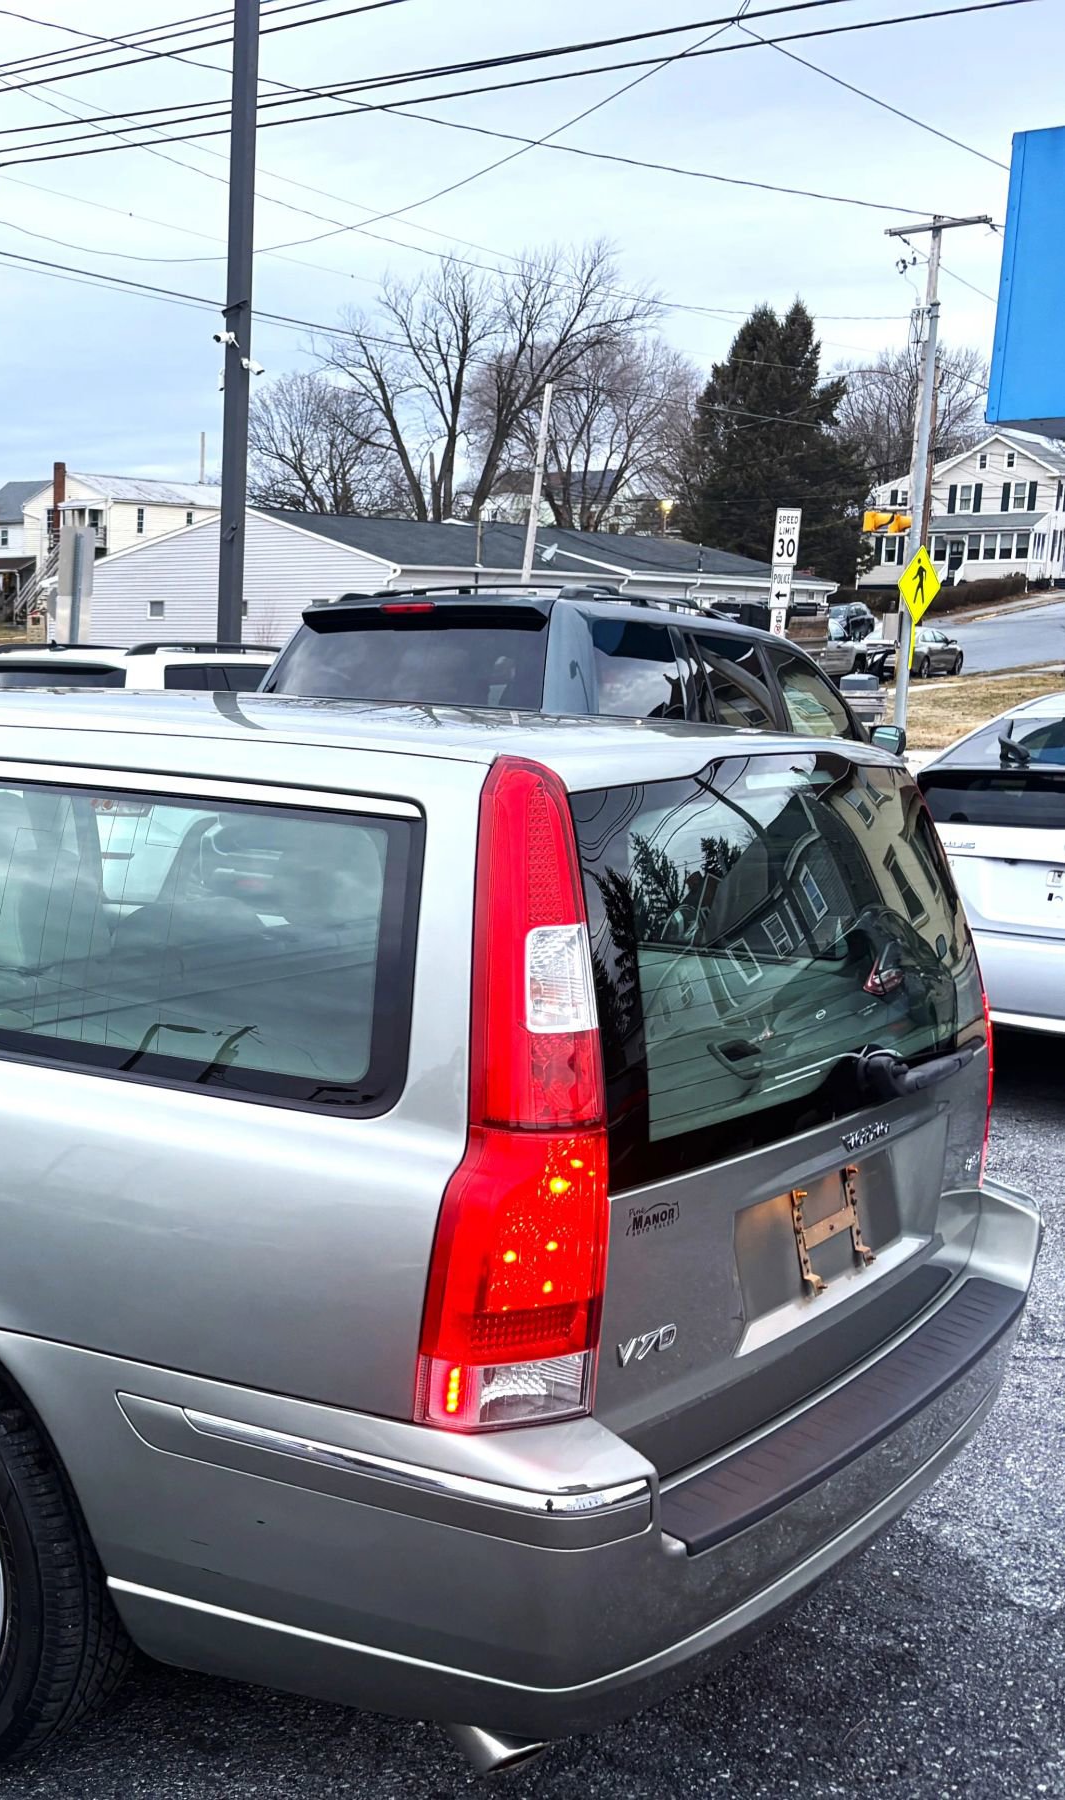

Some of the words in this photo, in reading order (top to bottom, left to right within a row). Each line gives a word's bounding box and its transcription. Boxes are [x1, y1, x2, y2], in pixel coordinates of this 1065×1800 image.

[778, 515, 799, 524] SPEED
[779, 526, 795, 535] LIMIT
[776, 538, 796, 557] 30
[773, 573, 791, 585] POLICE
[632, 1207, 675, 1231] MANOR
[616, 1323, 677, 1368] V70
